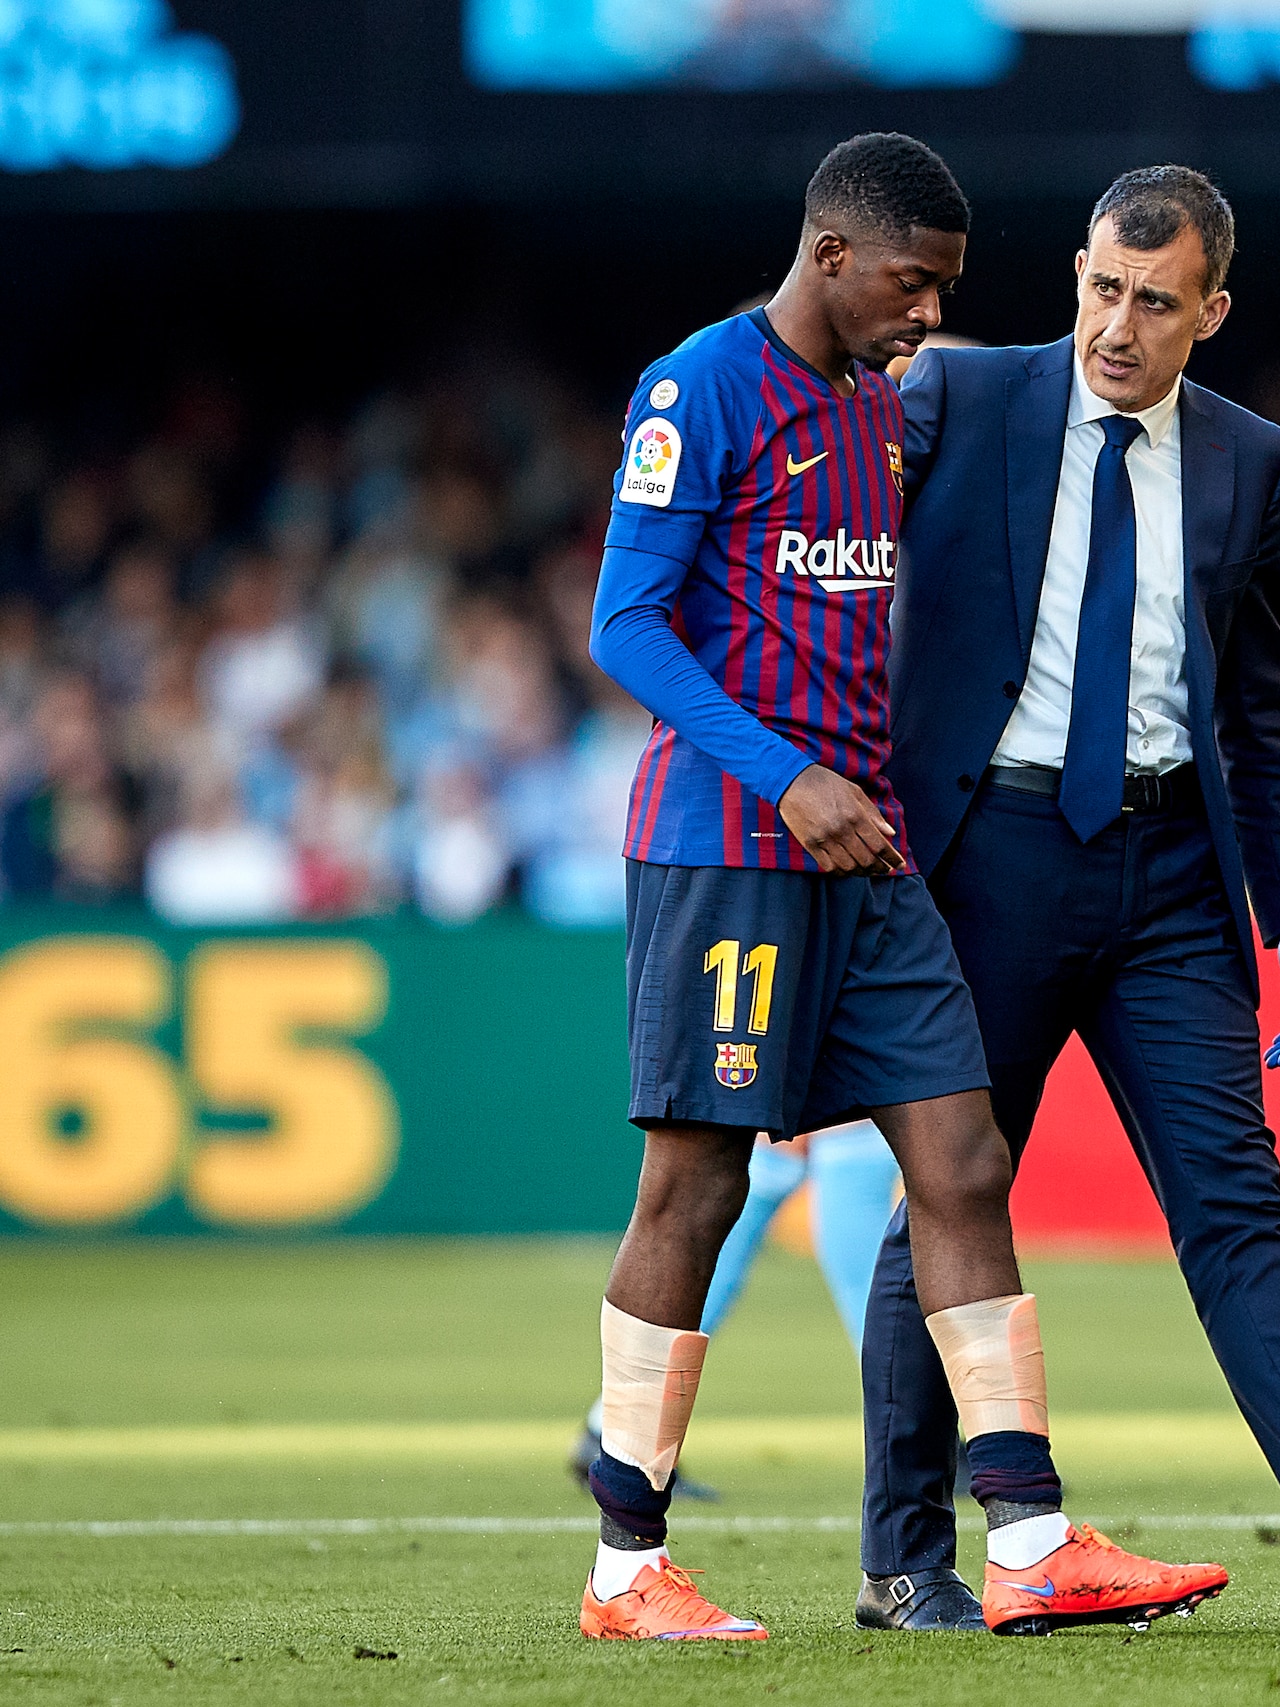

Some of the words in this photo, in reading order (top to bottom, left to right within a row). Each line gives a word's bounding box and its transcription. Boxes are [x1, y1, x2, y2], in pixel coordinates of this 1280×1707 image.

[628, 478, 665, 494] LaLiga
[775, 527, 896, 578] Rakut
[704, 940, 778, 1036] 11
